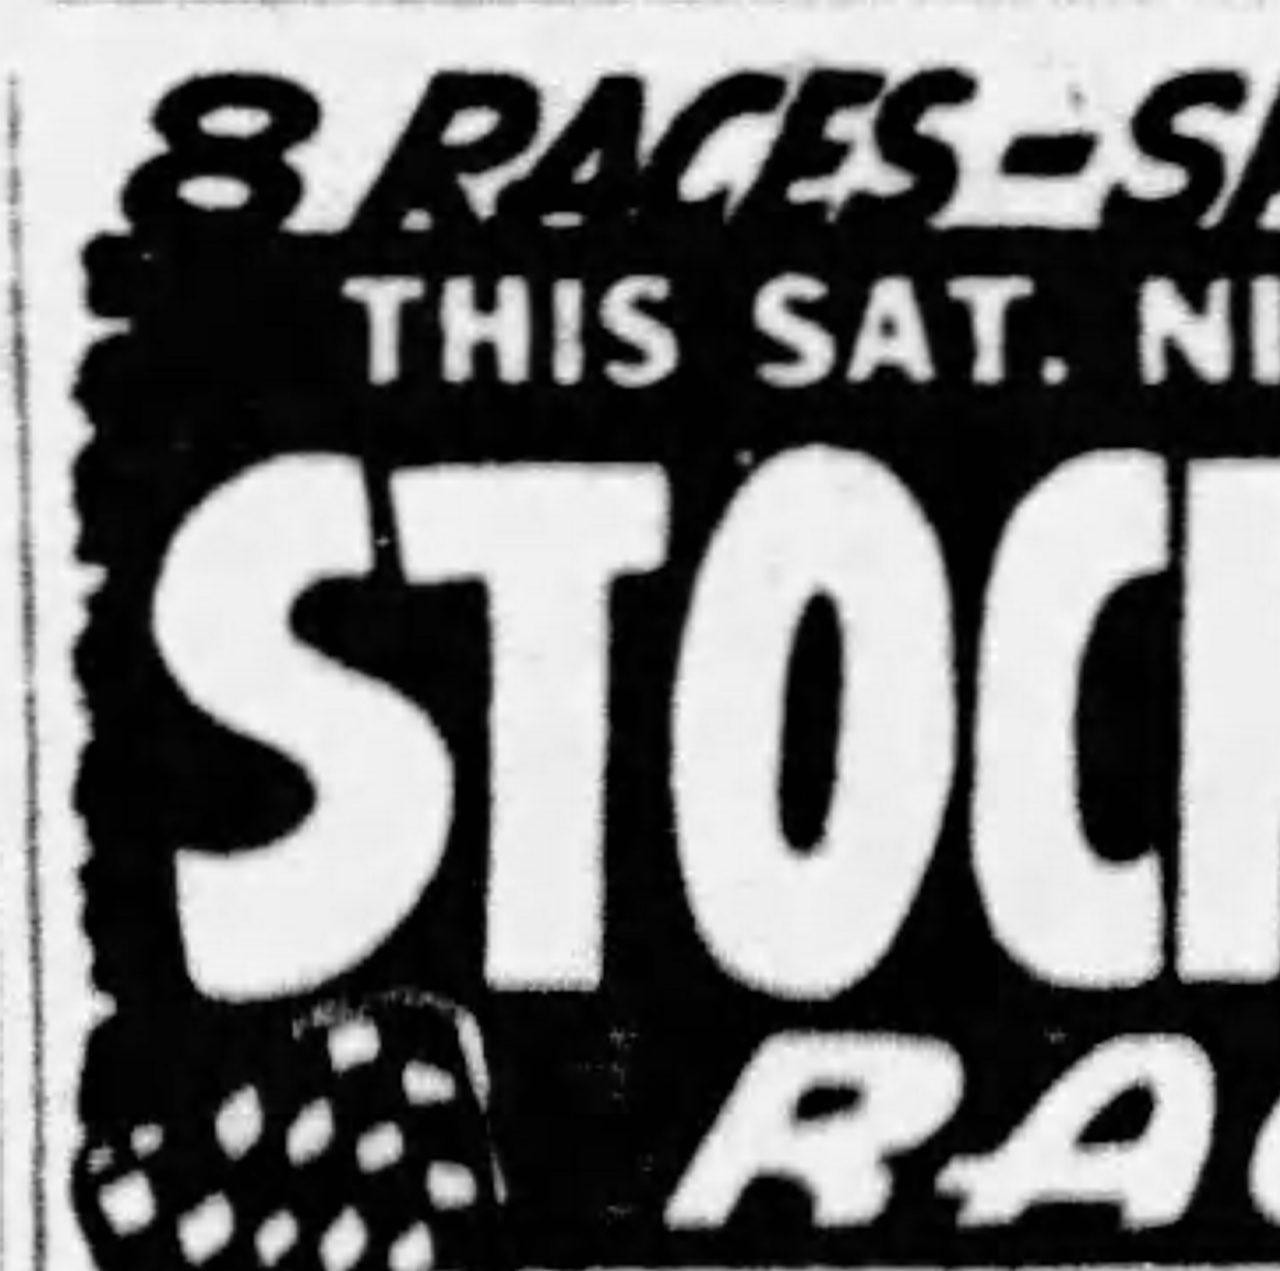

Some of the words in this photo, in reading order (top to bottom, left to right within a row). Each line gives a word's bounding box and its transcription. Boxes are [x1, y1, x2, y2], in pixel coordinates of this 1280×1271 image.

[122, 70, 322, 235] 8
[342, 275, 678, 387] THIS
[754, 273, 1067, 387] SAT.
